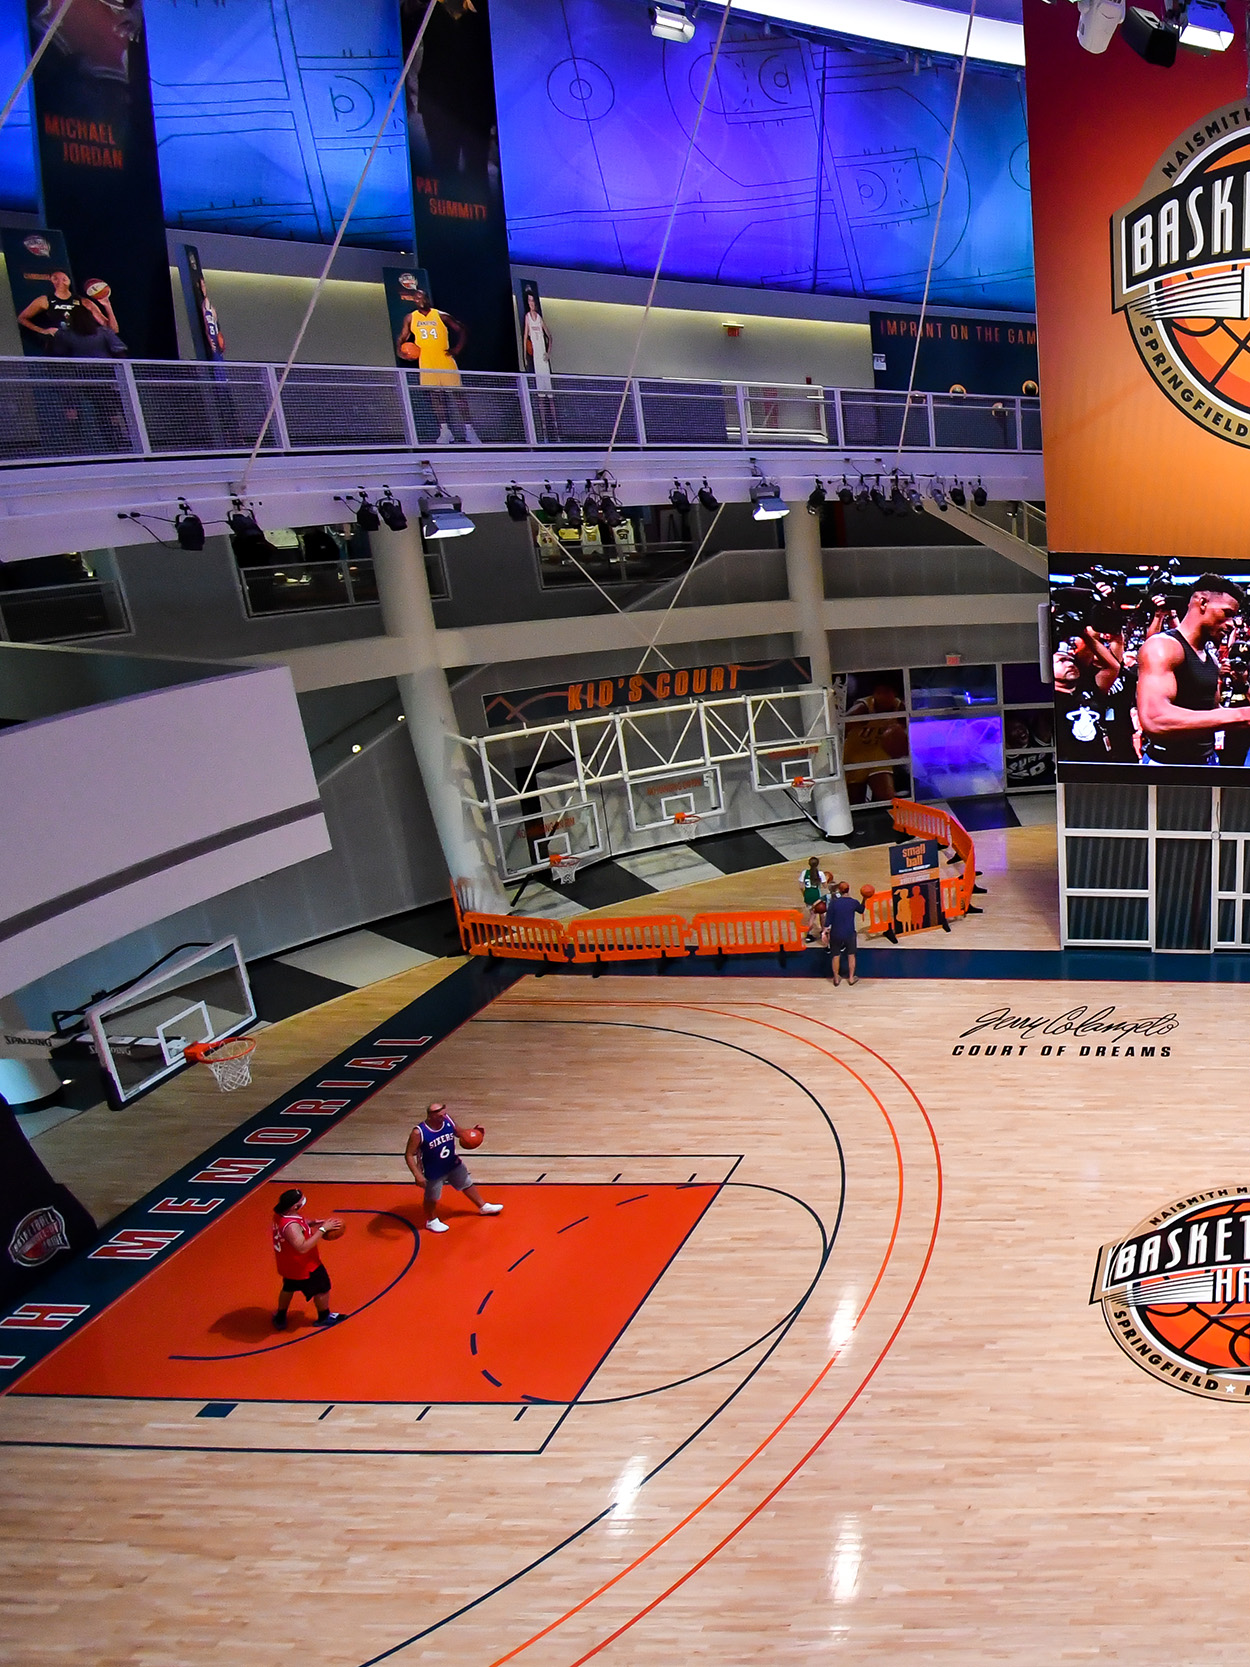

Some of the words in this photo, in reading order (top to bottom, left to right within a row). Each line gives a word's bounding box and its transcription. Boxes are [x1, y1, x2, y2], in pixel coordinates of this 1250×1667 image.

[44, 112, 116, 145] MICHAEL
[63, 142, 123, 170] JORDAN
[416, 176, 439, 196] PAT
[429, 198, 488, 221] SUMMITT
[420, 328, 438, 339] 34
[951, 324, 969, 340] ON
[976, 326, 1000, 343] THE
[1008, 328, 1037, 345] GAM
[1139, 324, 1249, 438] SPRINGFIELD
[567, 673, 644, 712] KID'S
[656, 664, 741, 699] COURT
[902, 843, 926, 858] small
[906, 855, 923, 868] ball
[4, 1035, 52, 1048] SPALDING
[952, 1045, 1028, 1056] COURT
[1040, 1045, 1066, 1057] OF
[1079, 1046, 1172, 1057] DREAMS
[87, 1035, 433, 1260] MEMORIAL
[428, 1132, 454, 1149] SIXERS
[440, 1146, 451, 1159] 6
[1149, 1189, 1228, 1226] NAISMITH
[1113, 1310, 1219, 1392] SPRINGFIELD
